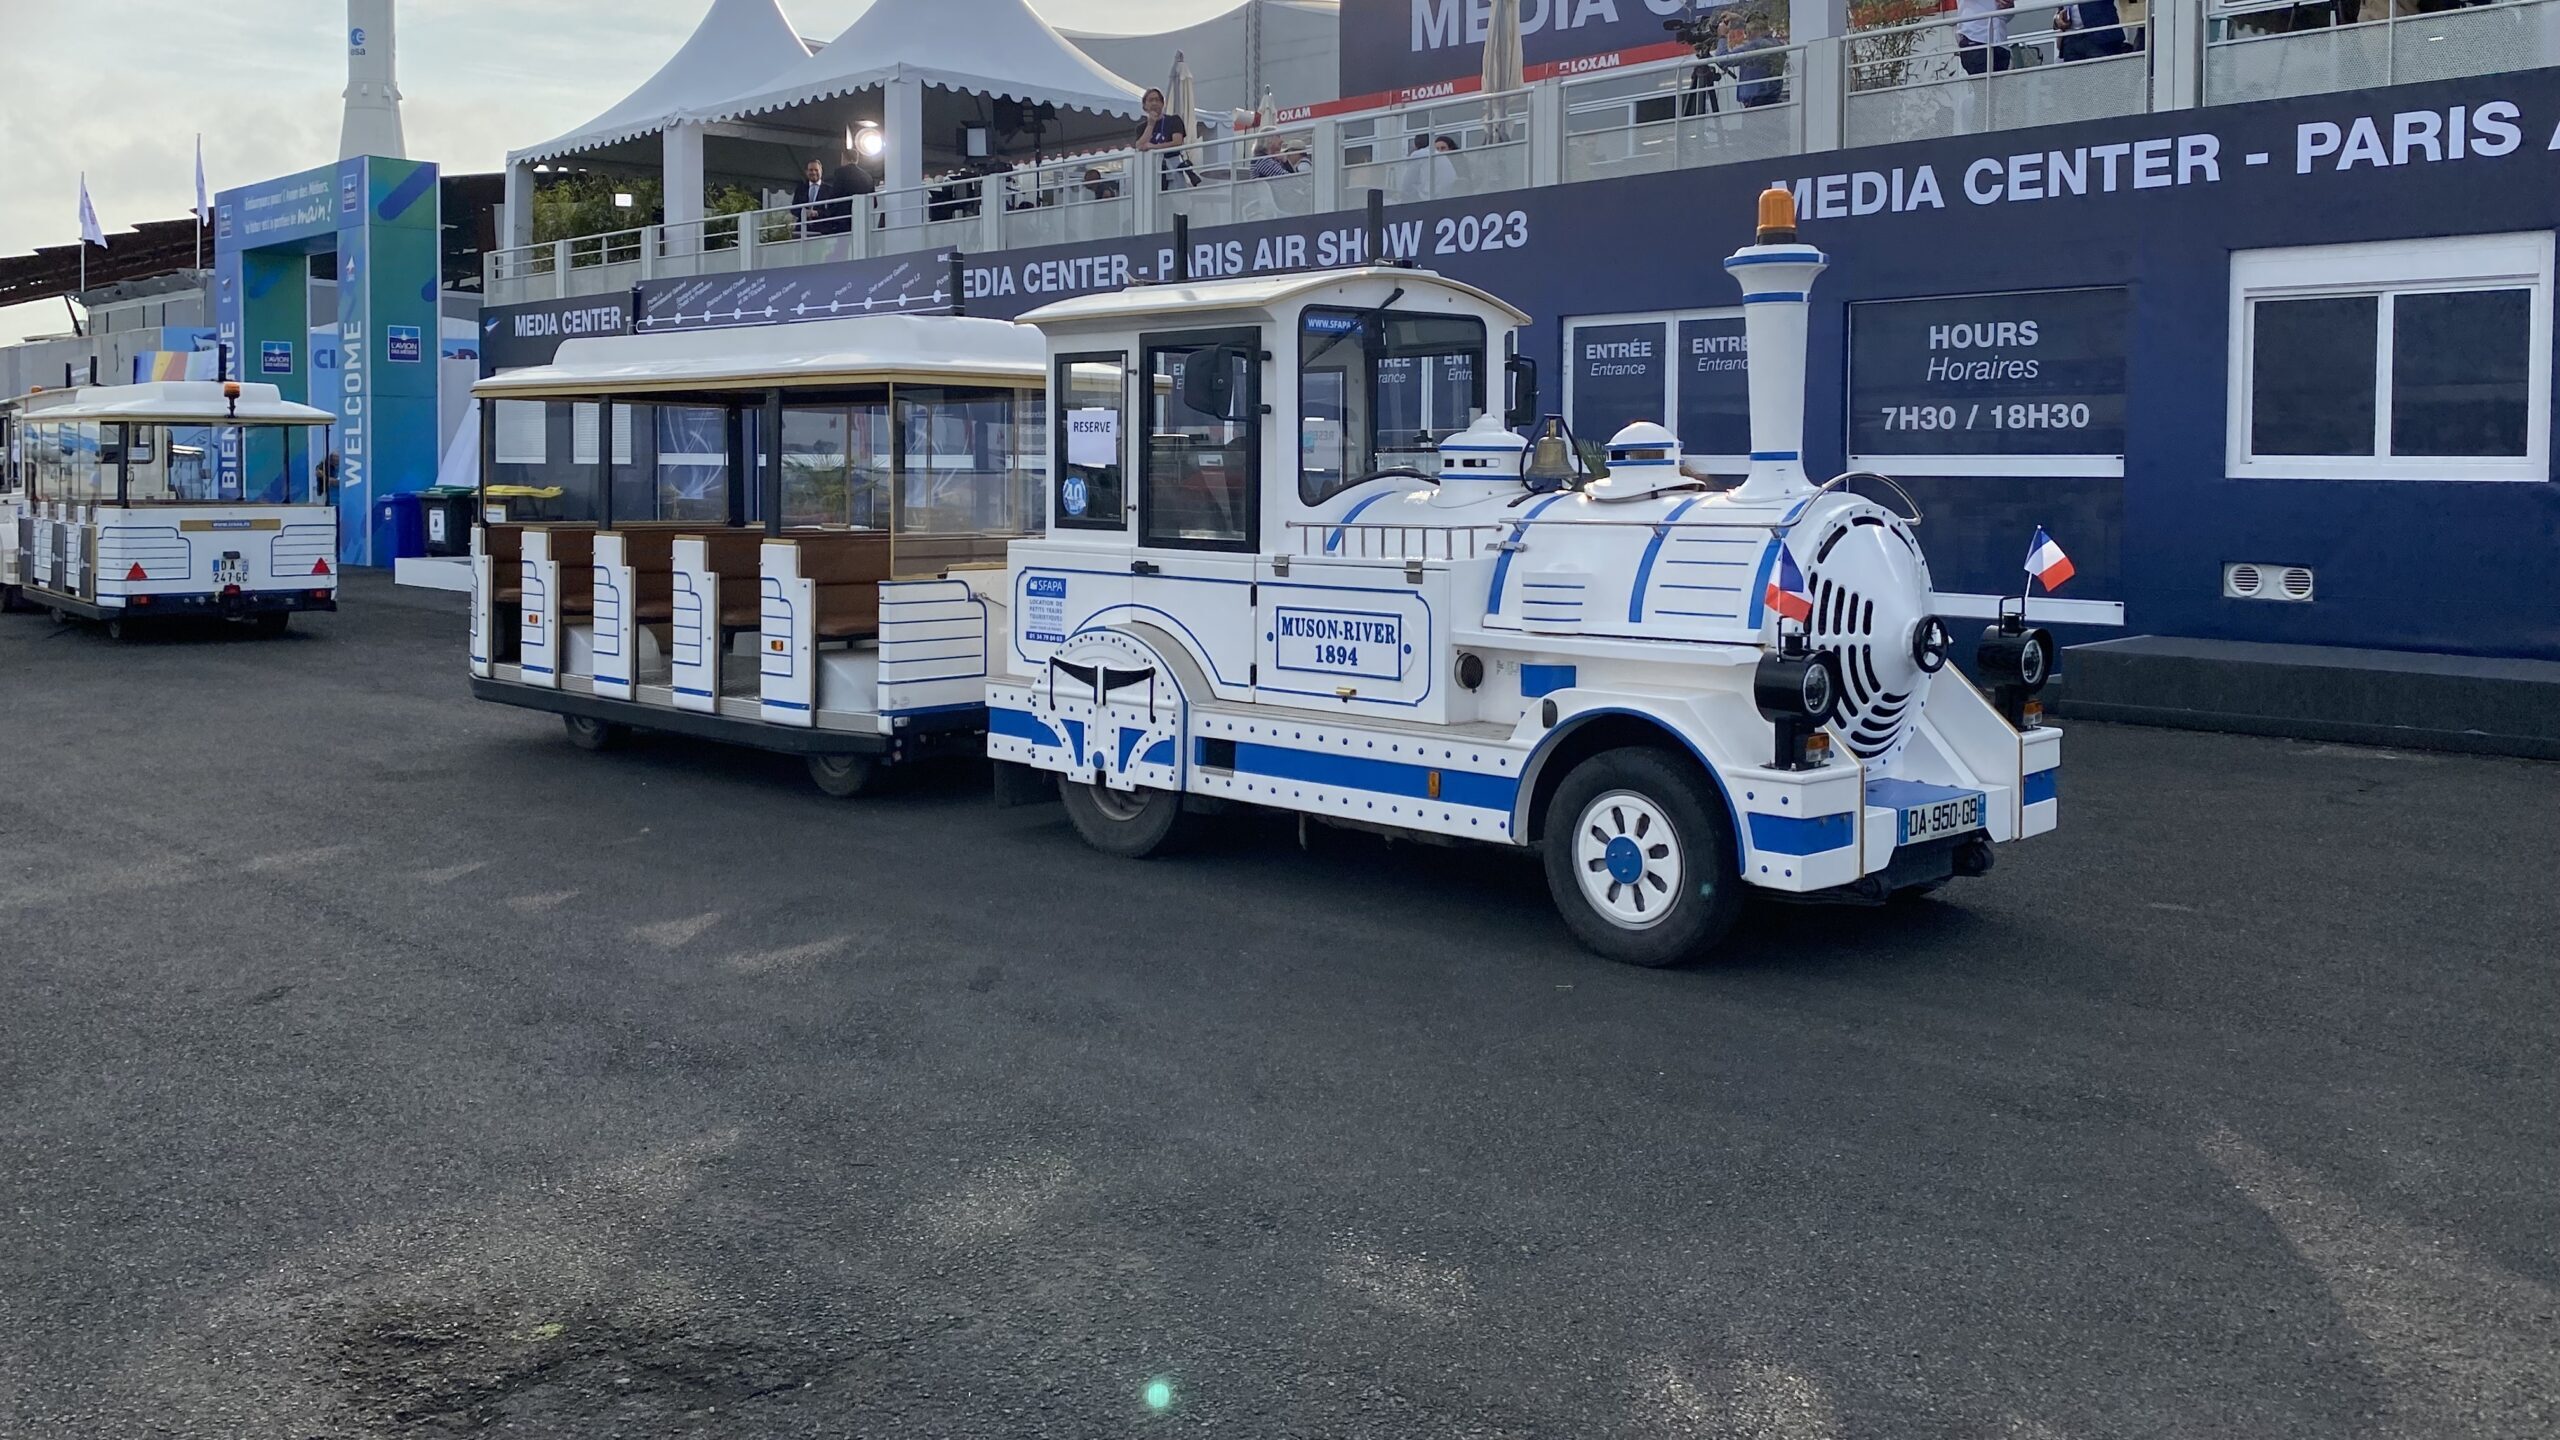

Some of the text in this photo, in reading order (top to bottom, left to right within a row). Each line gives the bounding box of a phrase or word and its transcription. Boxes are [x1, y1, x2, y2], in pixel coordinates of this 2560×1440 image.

[1570, 53, 1620, 74] LOXAM
[1411, 82, 1454, 101] LOXAM
[1963, 132, 2221, 206] CENTER
[2296, 100, 2522, 174] PARIS
[963, 266, 1016, 299] EDIA
[1023, 253, 1129, 294] CENTER
[1253, 234, 1306, 271] AIR
[1434, 209, 1529, 255] 2023
[514, 312, 559, 337] MEDIA
[561, 305, 621, 334] CENTER
[1929, 320, 2039, 350] HOURS
[1586, 337, 1652, 360] ENTRÉE
[1590, 361, 1646, 377] Entrance
[1697, 356, 1749, 373] Entranc
[1926, 354, 2039, 382] Horaires
[344, 320, 362, 488] WELCOME
[1073, 421, 1111, 433] RESERVE
[1881, 402, 2090, 431] 7H30 / 18H30
[1038, 579, 1063, 592] SFAPA
[1029, 599, 1054, 607] LOCATION
[1046, 607, 1063, 615] TRAINS
[1315, 644, 1358, 666] 1894
